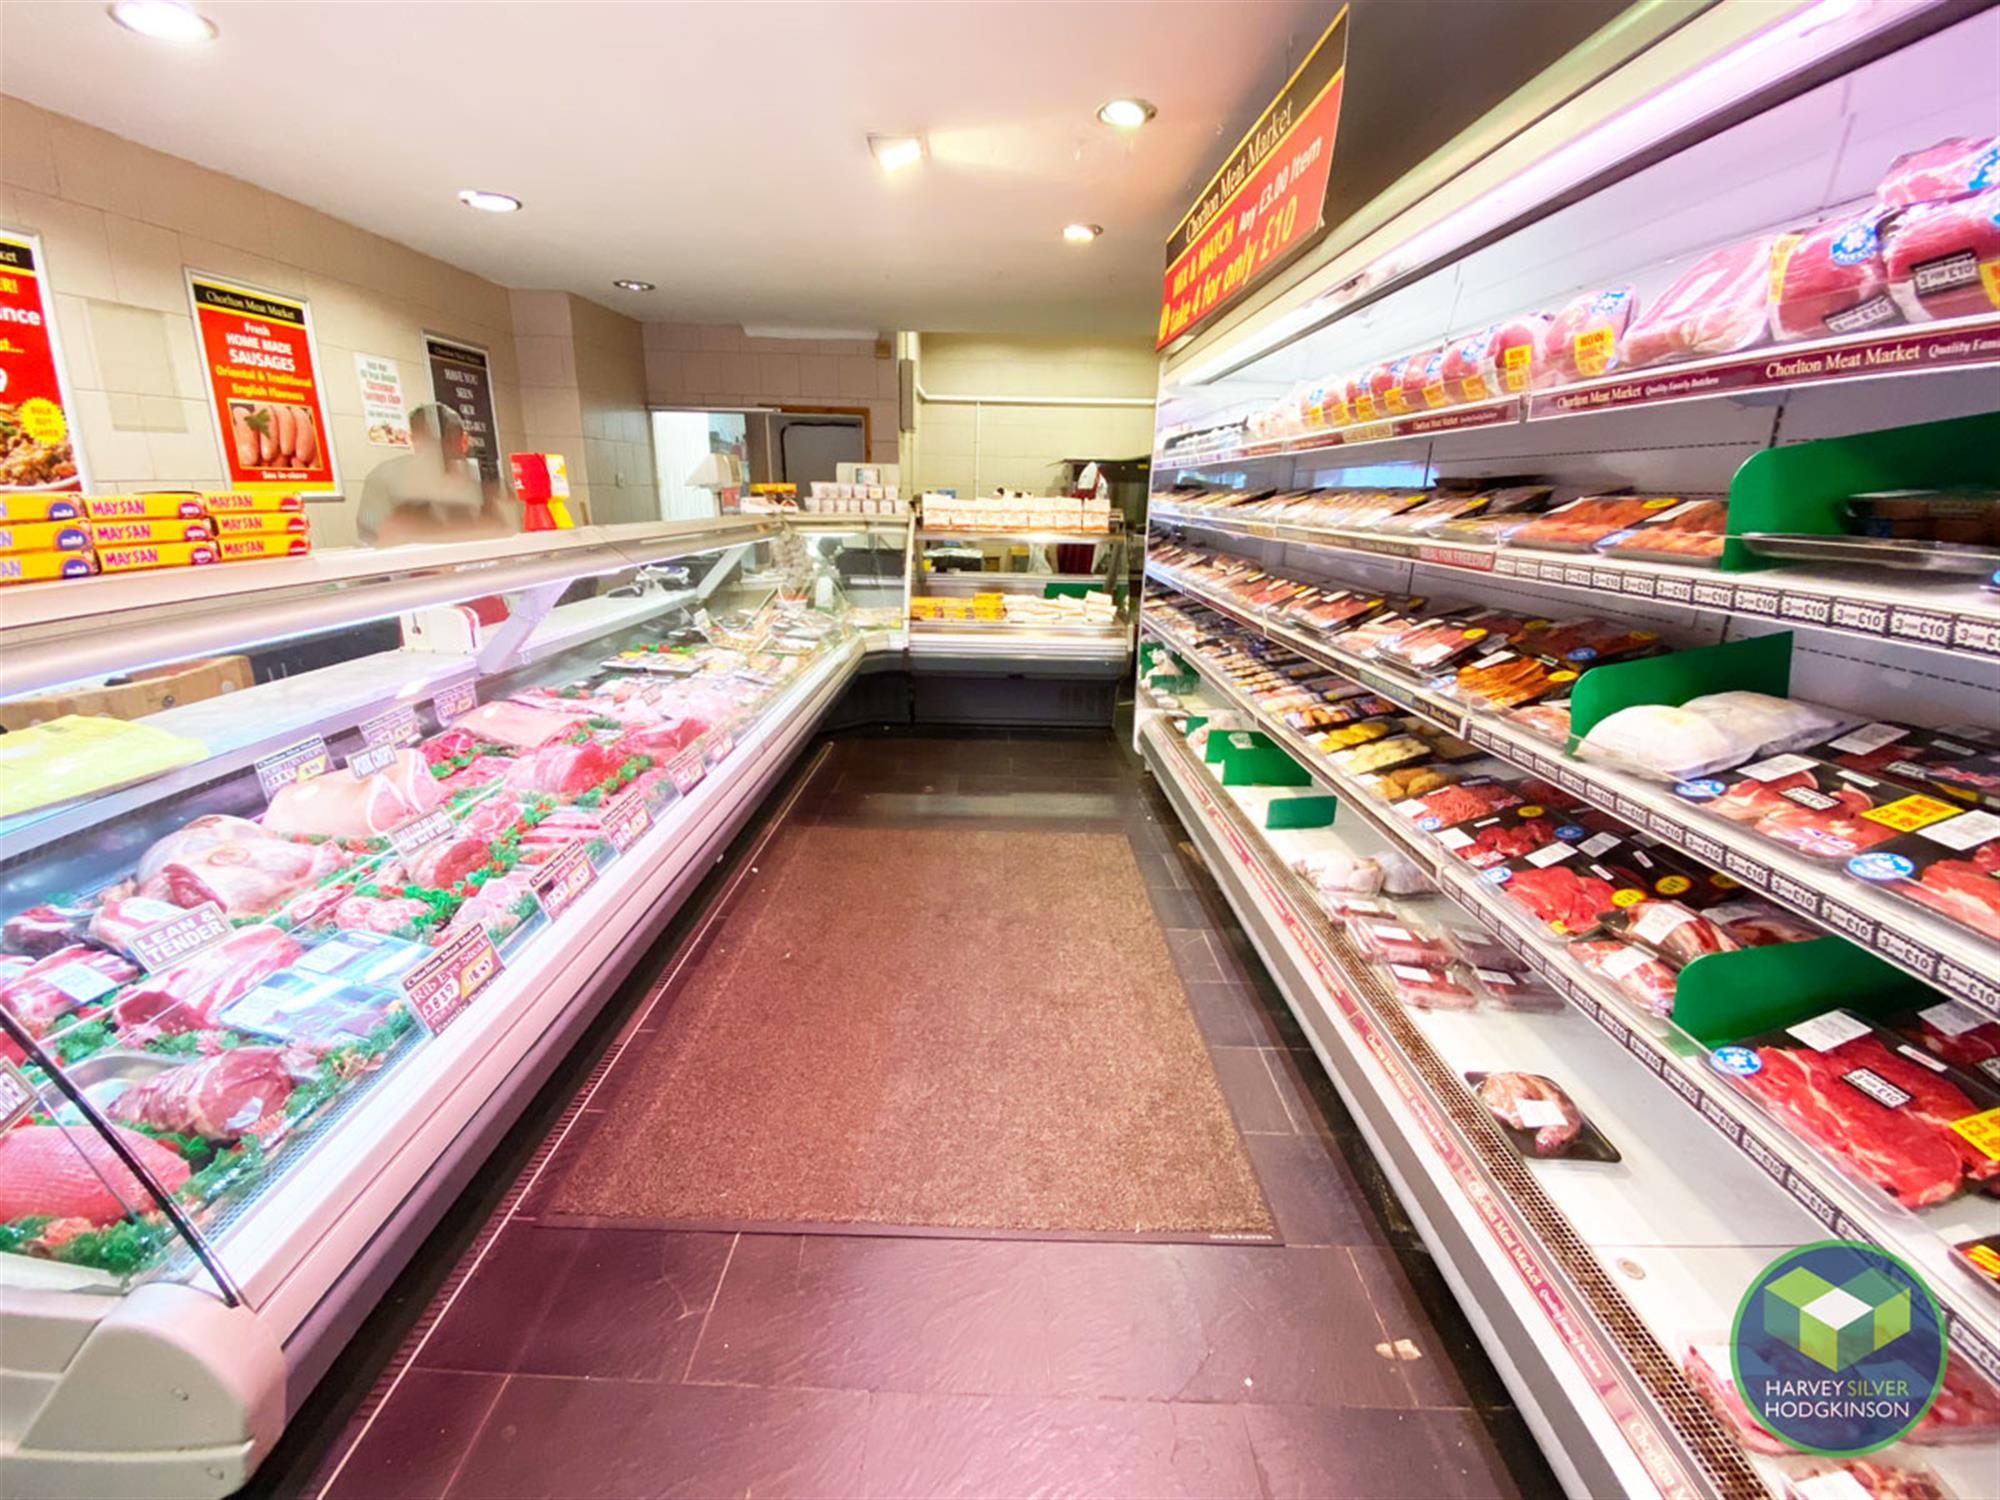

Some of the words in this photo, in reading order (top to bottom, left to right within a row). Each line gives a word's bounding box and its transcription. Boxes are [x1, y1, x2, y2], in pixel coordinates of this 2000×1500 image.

[1185, 193, 1219, 243] Chorlton
[1221, 156, 1246, 204] Meat
[1248, 98, 1292, 172] Market
[1198, 215, 1235, 275] MATCH
[1259, 165, 1289, 215] £3.00
[1290, 136, 1322, 184] Item
[1192, 283, 1202, 315] 4
[1202, 271, 1222, 309] for
[1223, 236, 1258, 291] only
[1259, 194, 1297, 261] £10
[0, 306, 41, 326] nce
[206, 291, 244, 308] Chorlton
[245, 299, 266, 313] Meat
[267, 304, 295, 320] Market
[244, 321, 271, 337] Fresh
[225, 332, 260, 350] HOME
[261, 339, 293, 356] MADE
[229, 349, 296, 372] SAUSAGES
[1766, 361, 1822, 378] Chorlton
[1825, 353, 1861, 371] Meat
[1864, 344, 1920, 365] Market
[1929, 342, 1970, 359] Quality
[215, 364, 256, 380] Oriental
[266, 372, 312, 388] Traditional
[231, 383, 267, 397] English
[1558, 395, 1589, 408] Chorlton
[1590, 391, 1611, 403] Meat
[1612, 385, 1641, 400] Market
[92, 499, 145, 515] MAYSAN
[97, 523, 150, 540] MAYSAN
[104, 548, 158, 566] MAYSAN
[1756, 596, 1774, 610] £10
[1804, 602, 1824, 617] £10
[1858, 613, 1881, 627] £10
[1919, 622, 1944, 637] £10
[1794, 887, 1814, 907] £10
[137, 918, 196, 952] LEAN
[201, 909, 216, 922] &
[1846, 917, 1869, 937] £10
[145, 920, 225, 962] TENDER
[406, 960, 442, 987] Chorlton
[441, 943, 461, 961] Meat
[459, 925, 482, 946] Market
[1904, 947, 1929, 969] £10
[413, 981, 438, 1001] Rib
[436, 961, 461, 985] Eye
[460, 937, 490, 967] Steak
[1968, 984, 1996, 1006] £10
[1809, 1196, 1830, 1218] £10
[1468, 1179, 1497, 1225] Chorlton
[1494, 1217, 1518, 1249] Meat
[1512, 1246, 1542, 1287] Market
[1539, 1288, 1563, 1319] Quality
[1628, 1421, 1675, 1488] Chorlton
